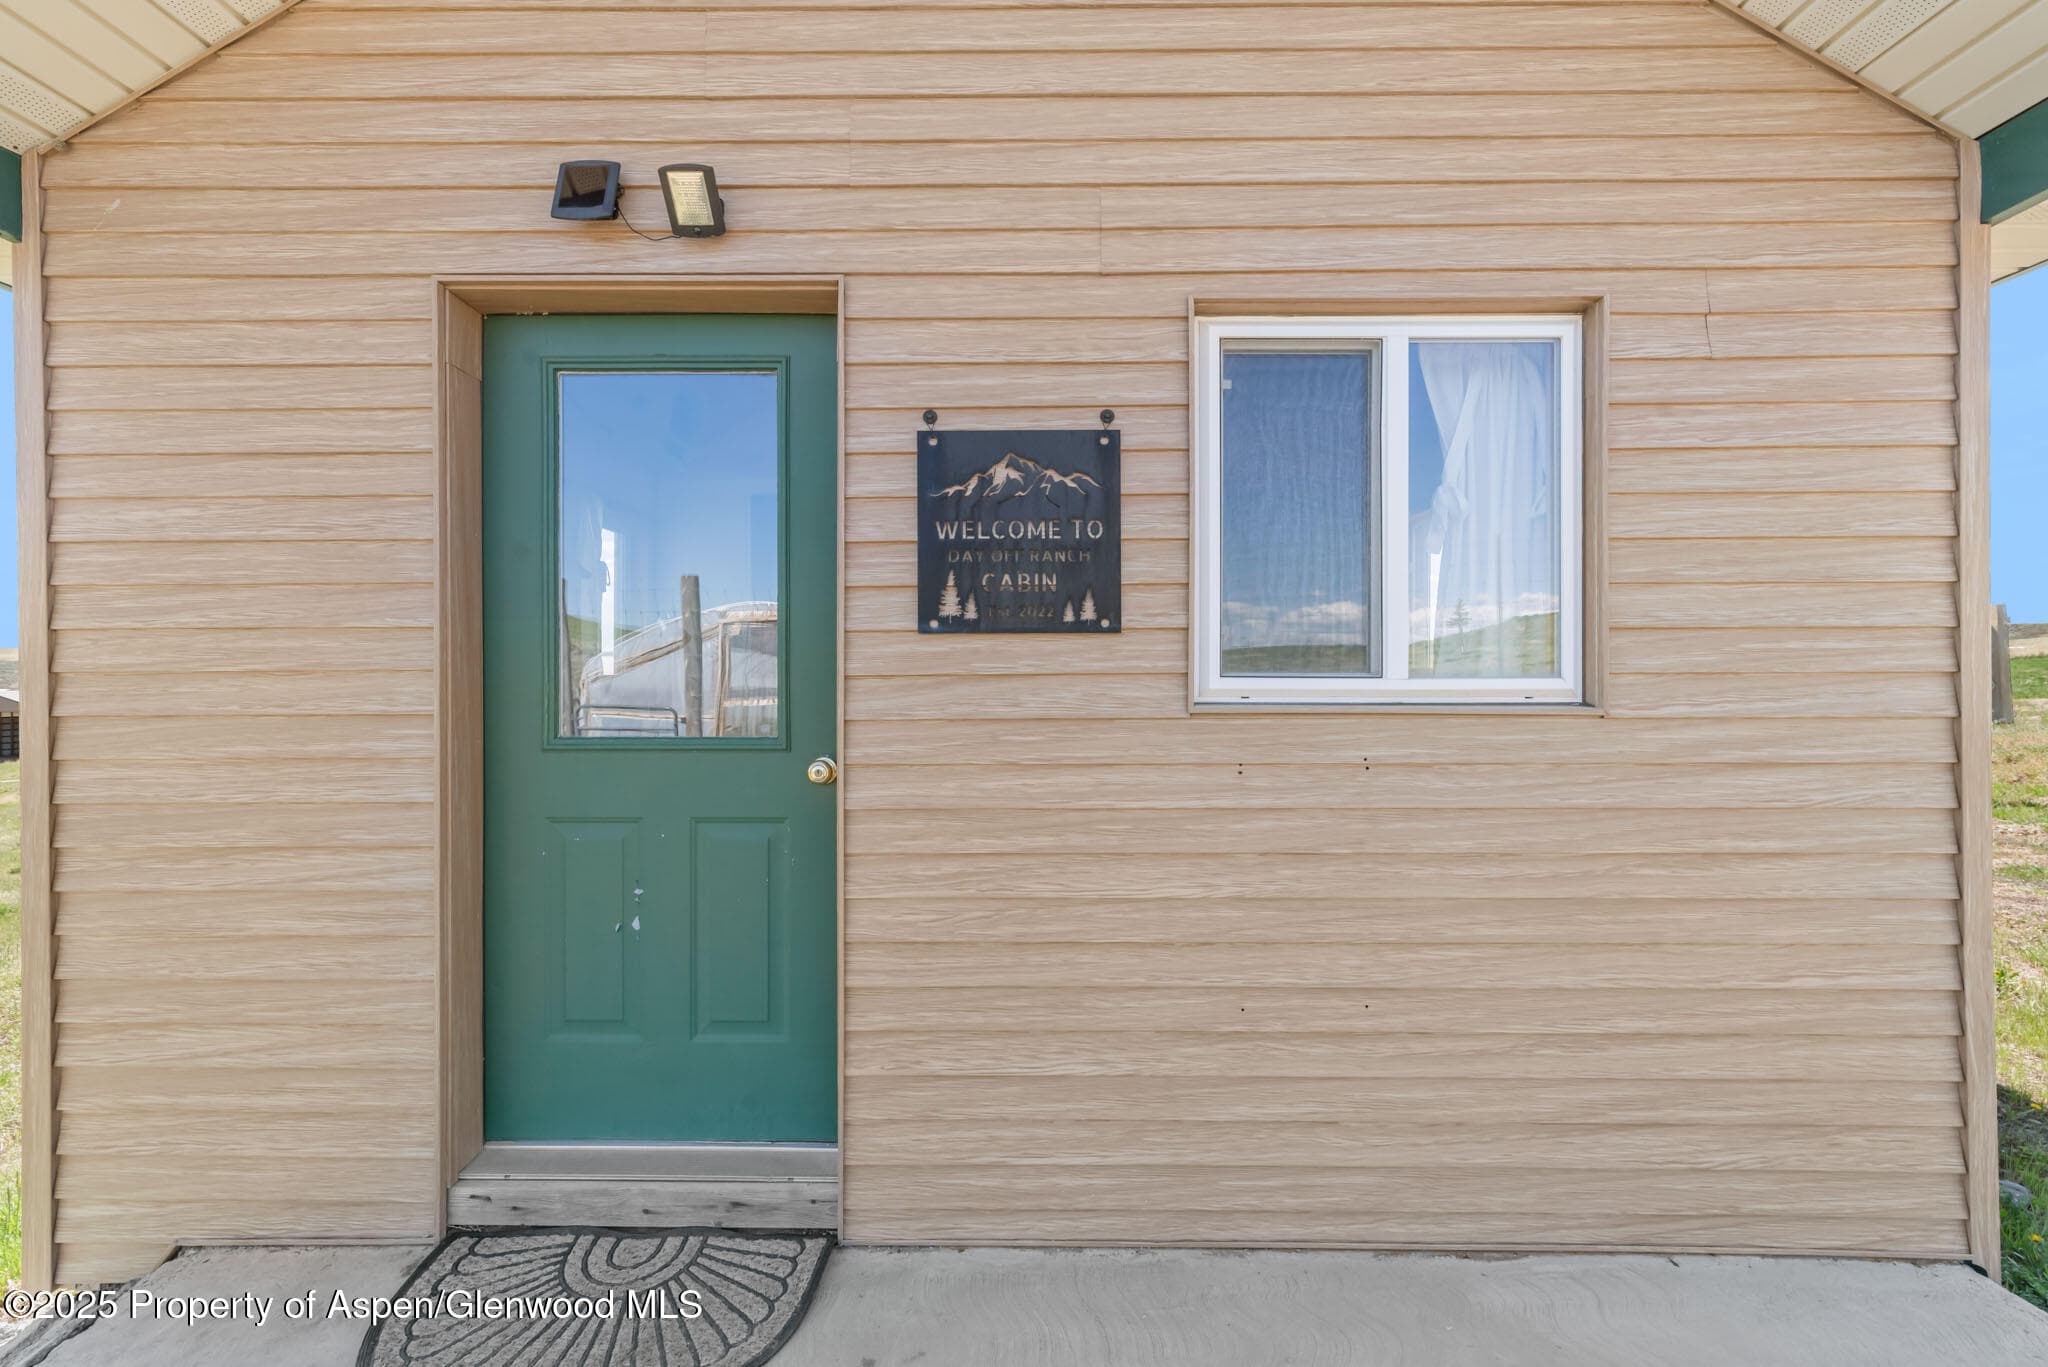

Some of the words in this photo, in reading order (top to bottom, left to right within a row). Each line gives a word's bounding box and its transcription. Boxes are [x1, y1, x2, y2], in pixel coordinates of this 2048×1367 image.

[935, 519, 1062, 540] WELCOME
[1071, 519, 1104, 540] TO
[948, 550, 984, 563] DAY
[991, 550, 1021, 563] OFF
[1029, 550, 1091, 563] RANCH
[981, 573, 1057, 593] CABIN
